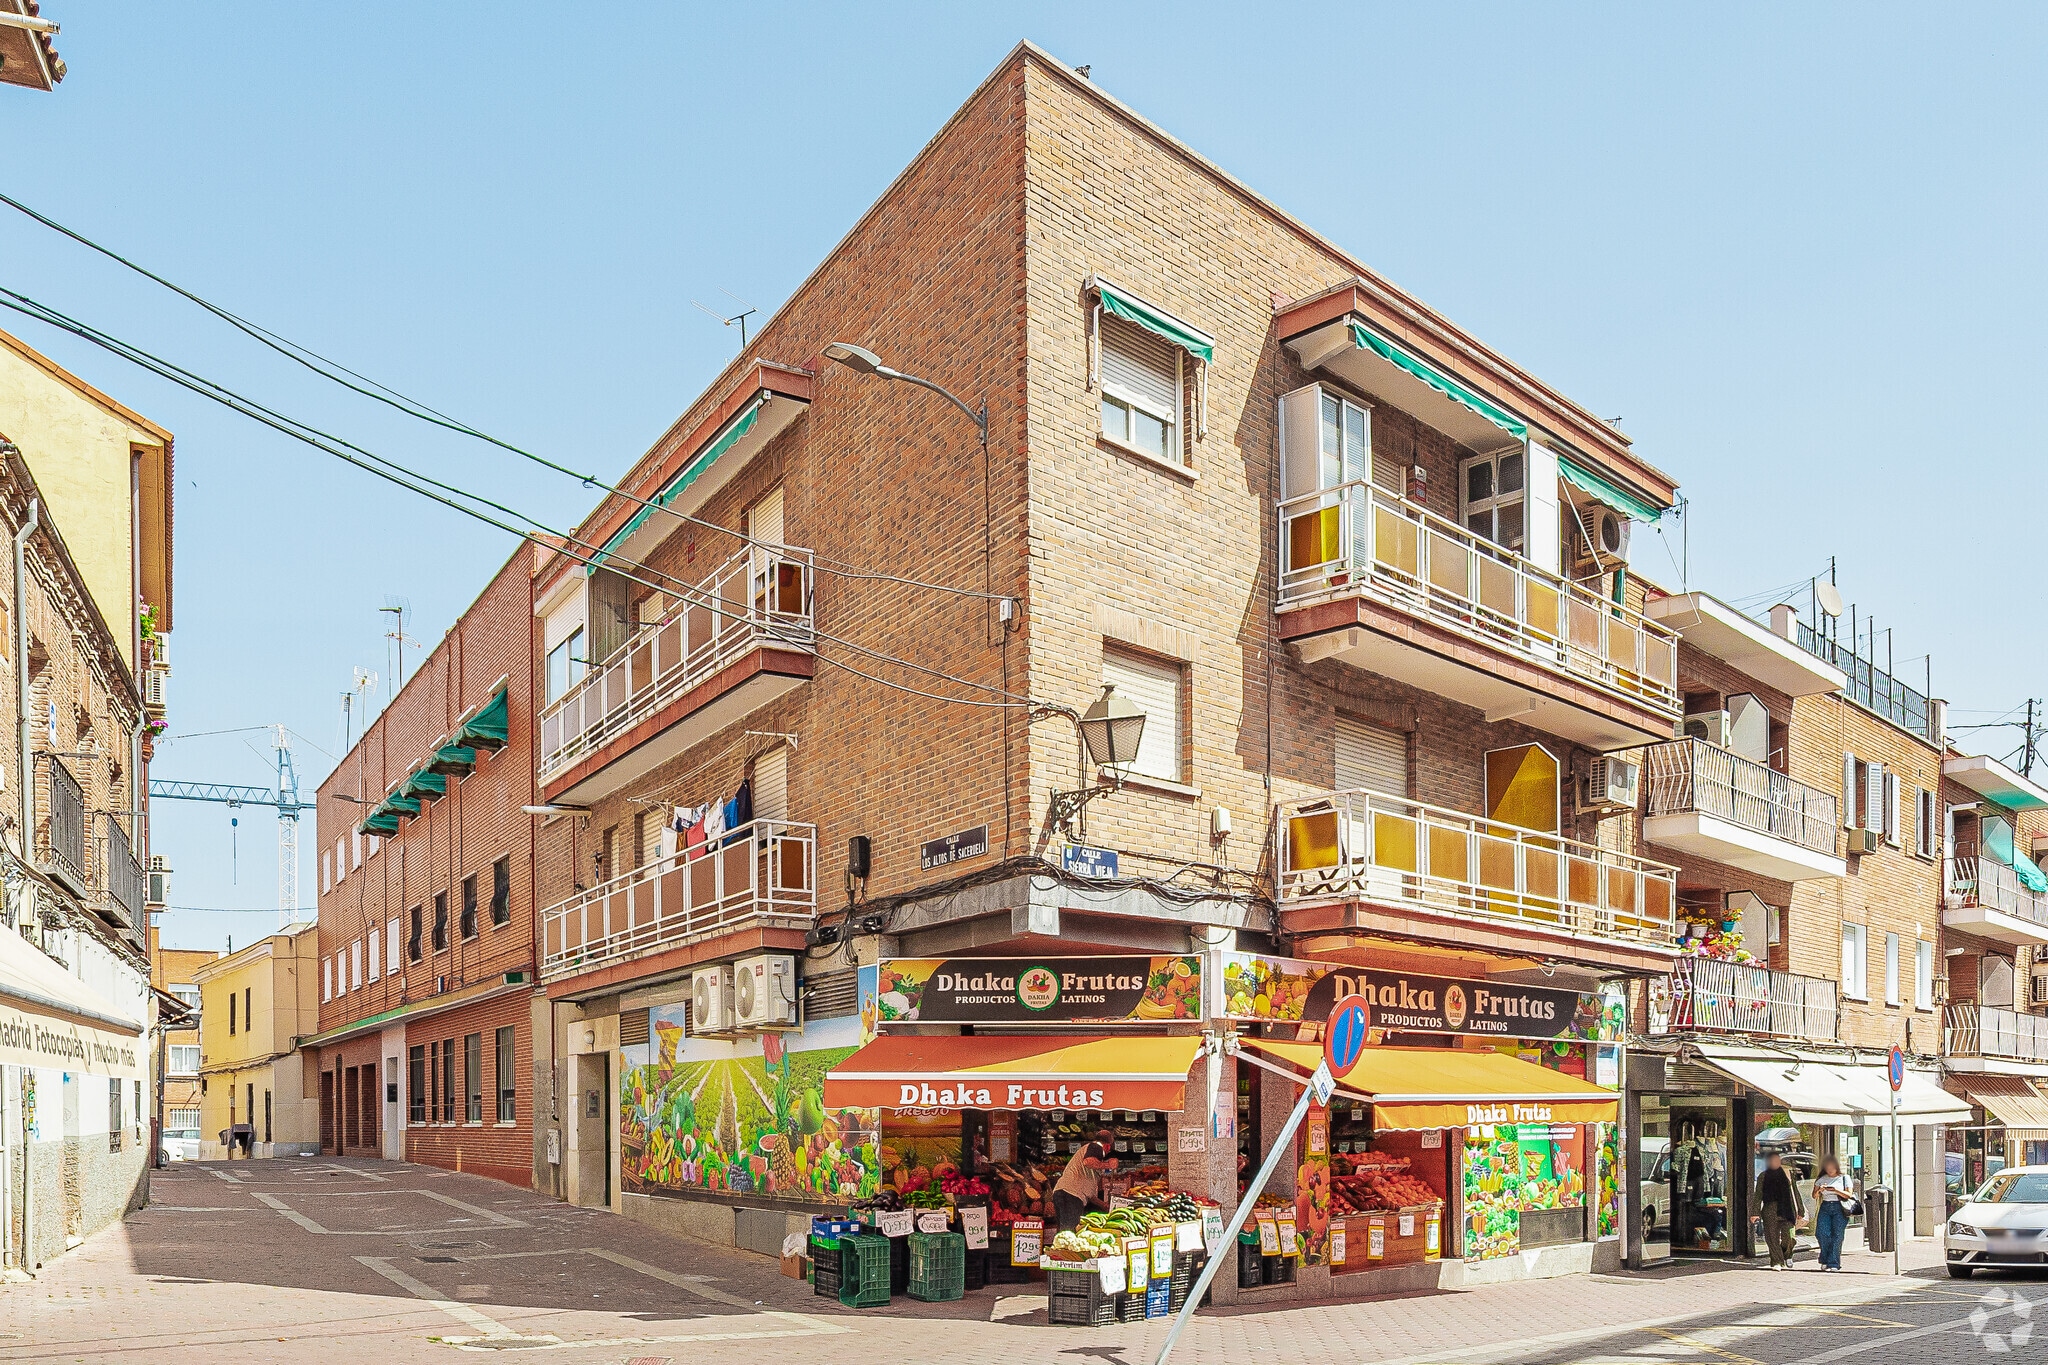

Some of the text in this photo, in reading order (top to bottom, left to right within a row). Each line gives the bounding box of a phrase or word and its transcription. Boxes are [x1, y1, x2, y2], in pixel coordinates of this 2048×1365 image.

[946, 834, 960, 845] CALLE
[921, 856, 931, 869] LOS
[933, 852, 948, 866] ALTOS
[949, 850, 956, 861] DE
[1082, 849, 1101, 860] CALLE
[1095, 865, 1114, 878] VIEJA
[937, 973, 1143, 992] Dhaka Frutas
[955, 994, 1106, 1004] PRODUCTOS LATINOS
[1333, 974, 1556, 1020] Dhaka Frutas
[1381, 1013, 1443, 1028] PRODUCTOS
[1469, 1019, 1508, 1032] LATINOS
[34, 1023, 84, 1063] Fotocopias
[85, 1040, 91, 1066] y
[93, 1040, 119, 1065] mucho
[899, 1083, 1104, 1106] Dhaka Frutas
[1467, 1103, 1552, 1123] Dhaka Frutas
[1014, 1221, 1043, 1229] OFERTA
